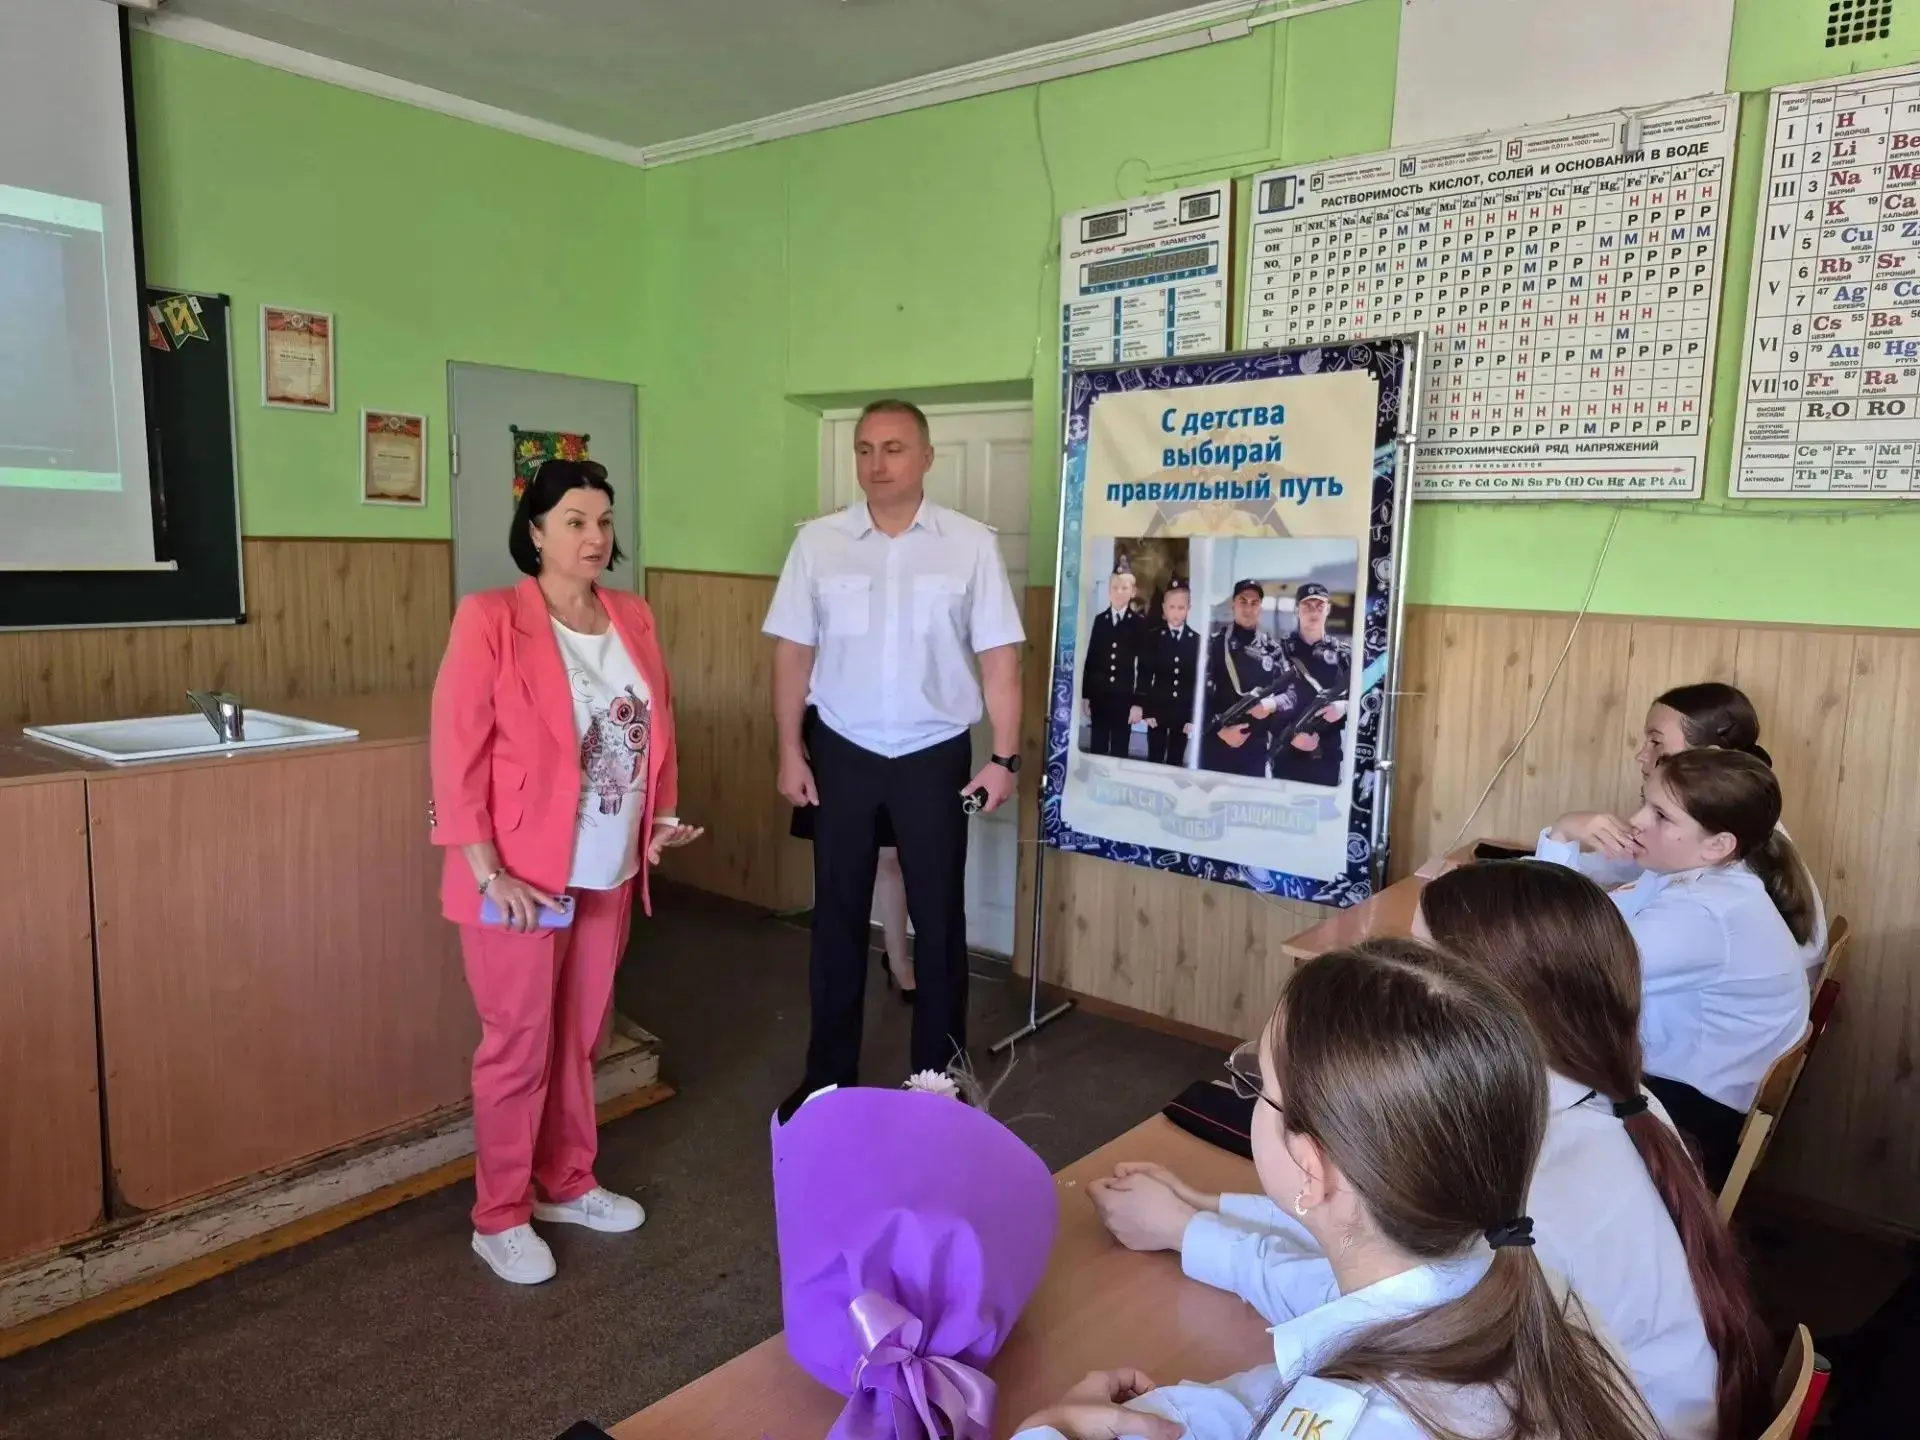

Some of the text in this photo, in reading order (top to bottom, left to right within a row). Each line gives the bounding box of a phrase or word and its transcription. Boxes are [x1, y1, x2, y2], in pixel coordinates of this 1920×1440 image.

[1816, 122, 1822, 134] 1
[1836, 112, 1856, 128] H
[1834, 128, 1870, 137] ВОДОРОД
[1510, 145, 1518, 156] Н
[1780, 134, 1920, 168] II 2 Li 3 Be
[1402, 162, 1412, 172] М
[1832, 158, 1856, 166] ЛИТИЙ
[1313, 178, 1320, 187] Р
[1321, 142, 1710, 208] РАСТВОРИМОСТЬ КИСЛОТ, СОЛЕЙ И ОСНОВАНИЙ В ВОДЕ
[1774, 181, 1796, 198] III
[1808, 180, 1818, 192] 3
[1829, 170, 1862, 186] Na
[1872, 166, 1882, 174] 11
[1828, 181, 1917, 196] НАТРИЙ МАГНИЙ
[1312, 186, 1712, 248] Р Р Р Р М М Н Н Н Н Н Н Н Н Н Н
[1804, 194, 1916, 222] 4 K 19 Ca
[1824, 210, 1918, 224] КАЛИЙ КАЛЬЦИЙ
[1160, 232, 1206, 246] ПАРАМЕТРОВ
[1770, 224, 1894, 250] IV 5 29 Cu 30
[1798, 254, 1906, 278] 6 Rb 37 Sr
[1818, 269, 1916, 282] РУБИДИЙ СТРОНЦИЙ
[1768, 281, 1780, 296] V
[1796, 295, 1805, 306] 7
[1834, 286, 1867, 302] Ag
[1874, 283, 1887, 291] 48
[1833, 302, 1866, 310] СЕРЕБРО
[1792, 312, 1904, 336] 8 Cs 55 Ba
[1760, 337, 1920, 362] VI 9 79 Au 80 Hg
[1752, 368, 1916, 394] VII 10 Fr 87 Ra 88
[1867, 400, 1906, 416] RO
[1162, 404, 1285, 436] С детства
[1162, 436, 1282, 470] выбирай
[1417, 440, 1658, 456] ЭЛЕКТРОХИМИЧЕСКИЙ РЯД НАПРЯЖЕНИЙ
[1798, 446, 1818, 456] Ce
[1836, 446, 1856, 456] Pr
[1878, 445, 1900, 456] Nd
[1424, 480, 1438, 488] Zn
[1441, 480, 1454, 488] Cr
[1475, 478, 1490, 486] Cd
[1511, 478, 1524, 486] Ni
[1528, 478, 1542, 486] Sn
[1546, 478, 1561, 486] Pb
[1565, 476, 1584, 487] (H)
[1587, 478, 1603, 486] Cu
[1608, 478, 1625, 487] Hg
[1628, 478, 1646, 487] Ag
[1650, 477, 1664, 486] Pt
[1668, 477, 1687, 486] Au
[1796, 469, 1888, 480] Th Pa U
[1106, 472, 1343, 508] правильный путь
[1280, 1407, 1332, 1440] ПК
